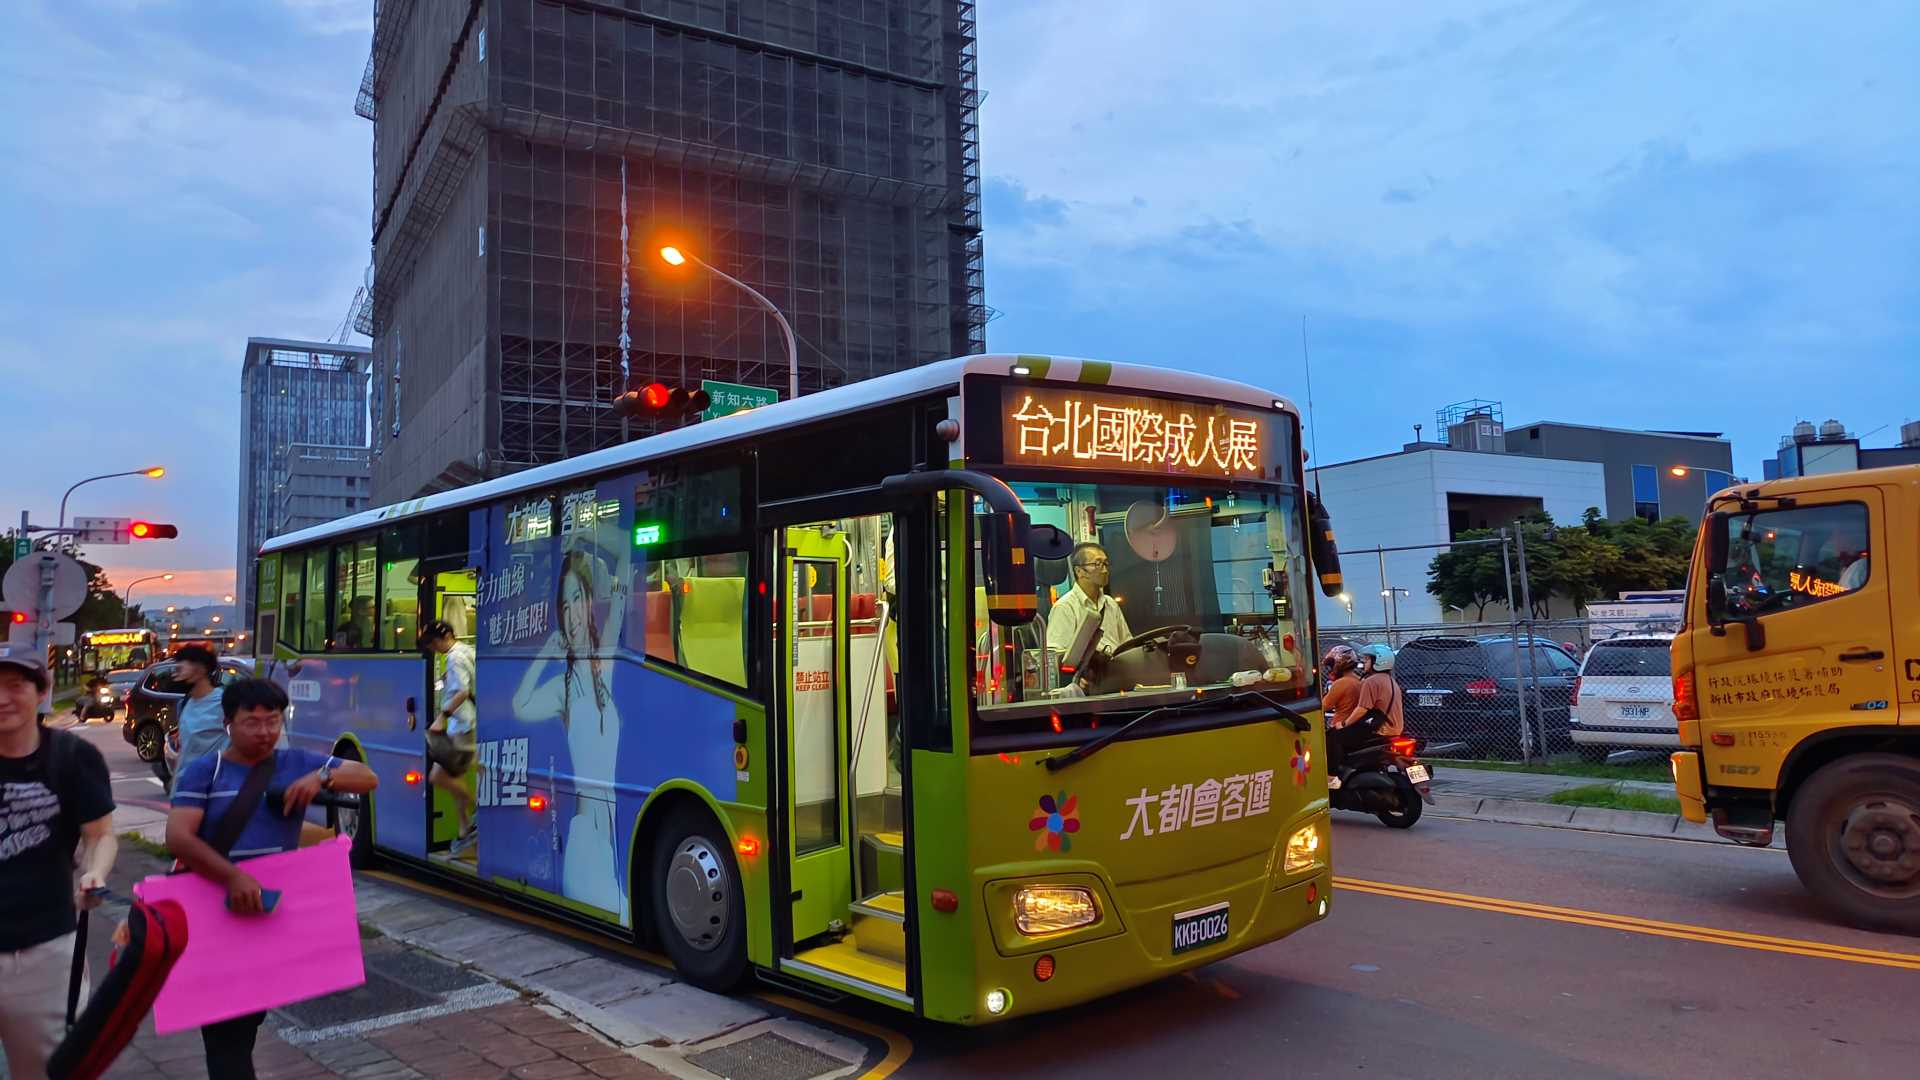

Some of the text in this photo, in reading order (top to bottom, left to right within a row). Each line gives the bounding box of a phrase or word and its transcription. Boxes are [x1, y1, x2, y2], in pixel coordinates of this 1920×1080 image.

[711, 390, 768, 408] 新知六路
[1012, 396, 1257, 470] 台北國際成人展
[796, 671, 829, 683] 禁止站立
[1120, 769, 1274, 840] 大都會客運
[1174, 913, 1229, 948] KKB-0026
